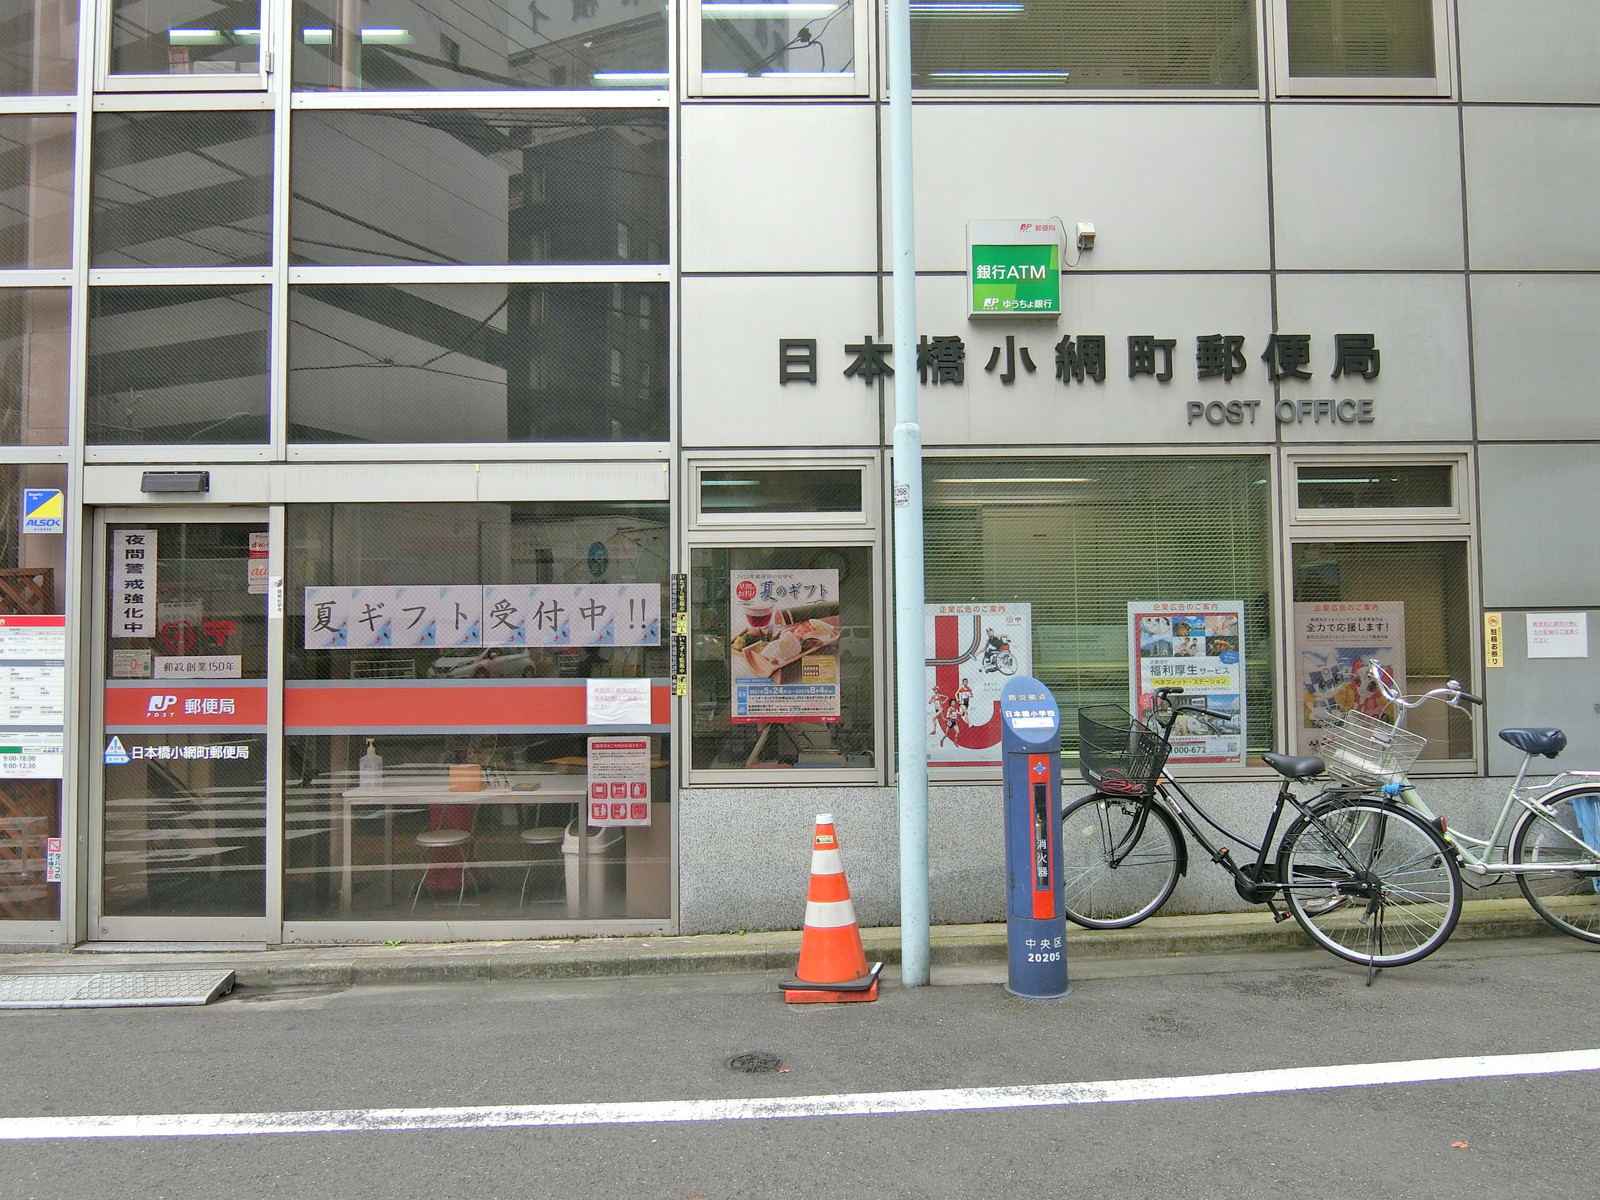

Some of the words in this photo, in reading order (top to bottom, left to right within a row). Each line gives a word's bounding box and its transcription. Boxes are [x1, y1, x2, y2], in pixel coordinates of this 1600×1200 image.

[976, 264, 1046, 280] 銀行ATM
[984, 298, 1000, 307] JP
[1002, 298, 1053, 309] ゆうちょ銀行
[779, 334, 1381, 385] 日本橋小網町郵便局
[1186, 399, 1261, 425] POST
[1275, 398, 1376, 424] OFFICE
[124, 534, 146, 633] 夜間警戒強化中
[760, 580, 827, 601] 夏のギフト
[310, 598, 647, 633] 夏ギフト受付中!!
[1306, 622, 1389, 632] 全力で応援します!
[163, 662, 235, 672] 郵政創業150年
[1150, 665, 1230, 676] 福利厚生サービス
[148, 695, 177, 712] JP
[184, 698, 235, 715] 郵便局
[1005, 710, 1056, 718] 日本橋小学校
[132, 746, 249, 760] 日本橋小網町郵便局
[1037, 839, 1048, 878] 消火器
[1025, 936, 1062, 950] 中央区
[1028, 953, 1061, 963] 20205
